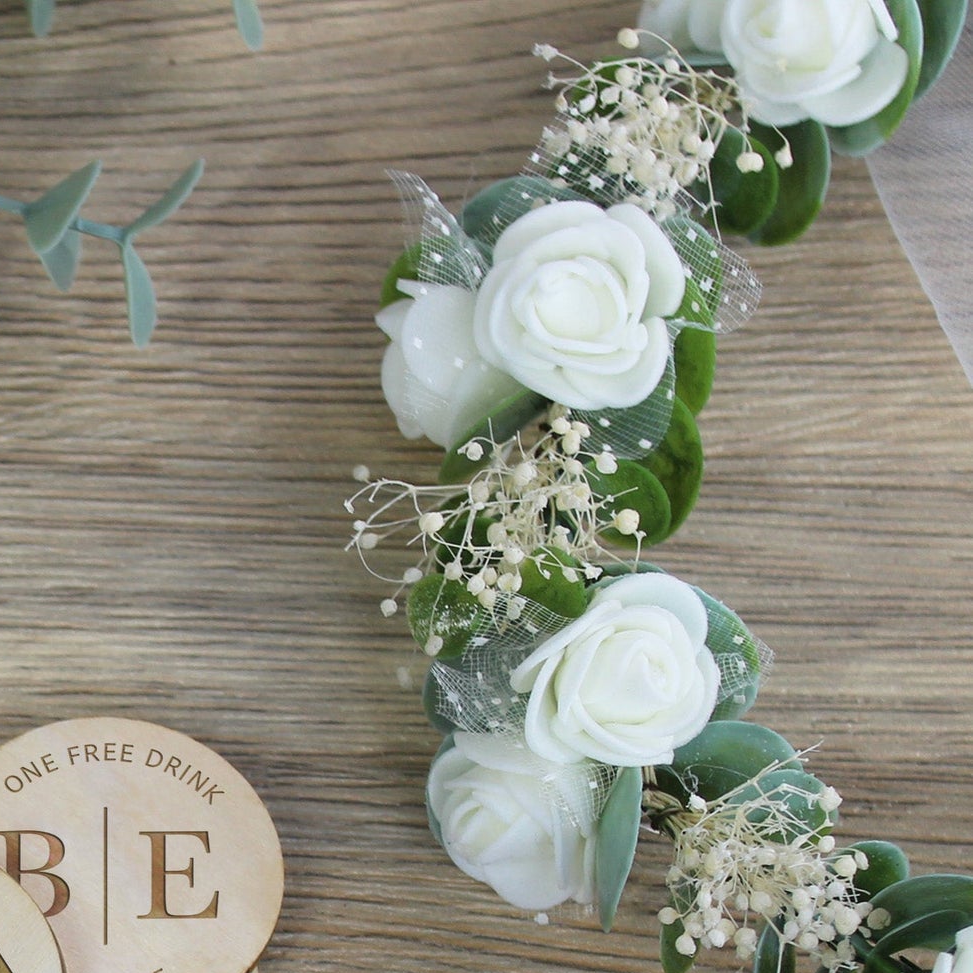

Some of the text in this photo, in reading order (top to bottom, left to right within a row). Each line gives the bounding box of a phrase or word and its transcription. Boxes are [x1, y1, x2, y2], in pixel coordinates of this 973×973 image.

[3, 742, 226, 805] ONE FREE DRINK
[136, 830, 220, 920] E
